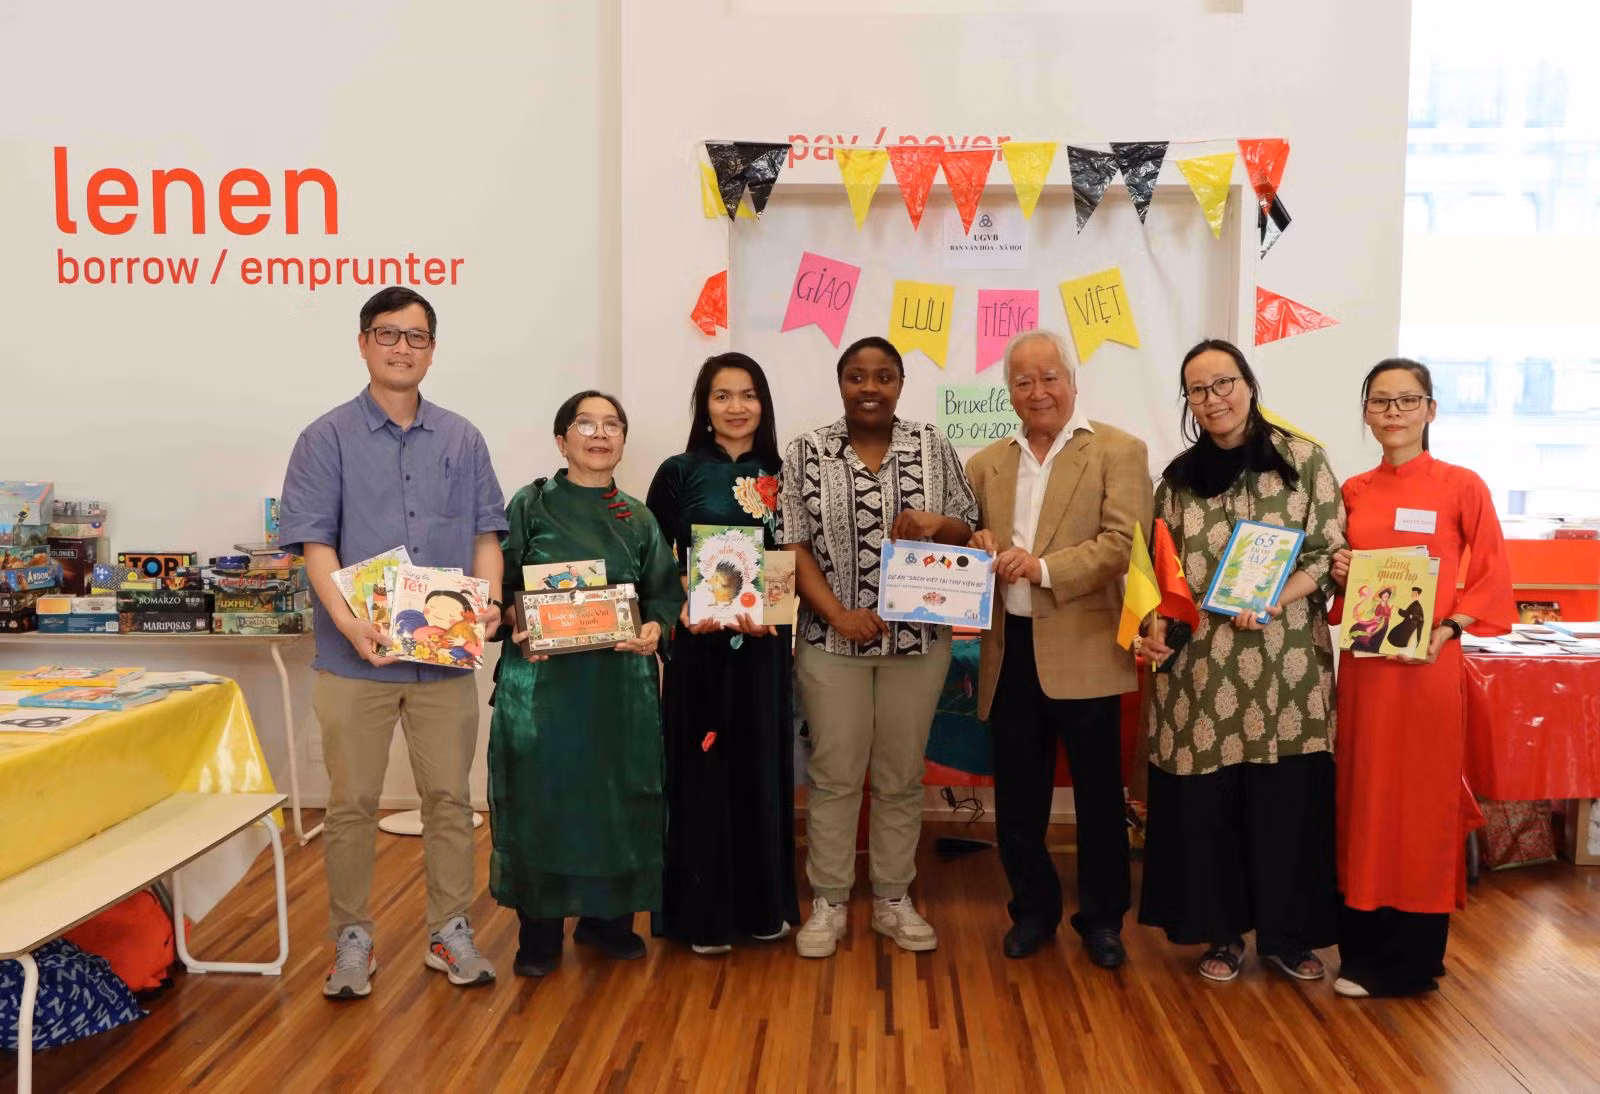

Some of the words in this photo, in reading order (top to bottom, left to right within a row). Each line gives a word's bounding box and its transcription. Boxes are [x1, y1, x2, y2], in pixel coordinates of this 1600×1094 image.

[54, 146, 339, 236] lenen
[974, 234, 999, 242] UGVB
[58, 248, 200, 285] borrow
[210, 248, 229, 284] /
[240, 252, 465, 291] emprunter
[945, 388, 1014, 415] Bruxelle
[1255, 532, 1279, 548] 65
[139, 597, 181, 605] BOMARZO
[220, 599, 254, 608] UXMAL
[237, 616, 279, 628] DOMINION
